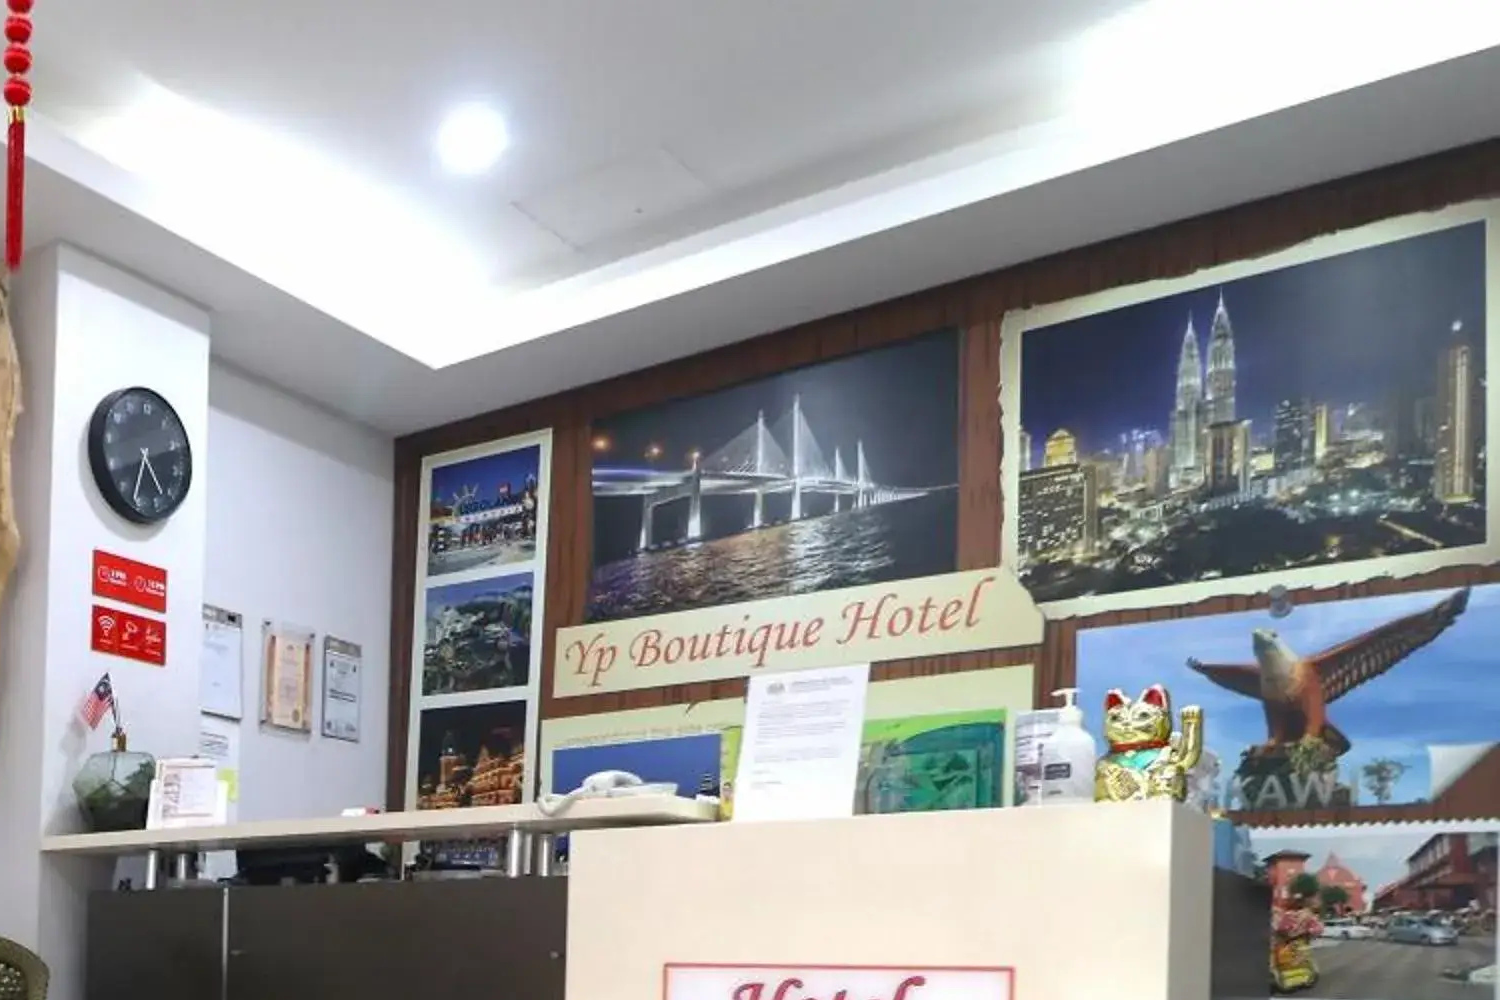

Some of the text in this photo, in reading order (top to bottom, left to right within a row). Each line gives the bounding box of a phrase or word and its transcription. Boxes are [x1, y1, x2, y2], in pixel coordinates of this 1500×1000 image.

[566, 576, 996, 688] Yp Boutique Hotel
